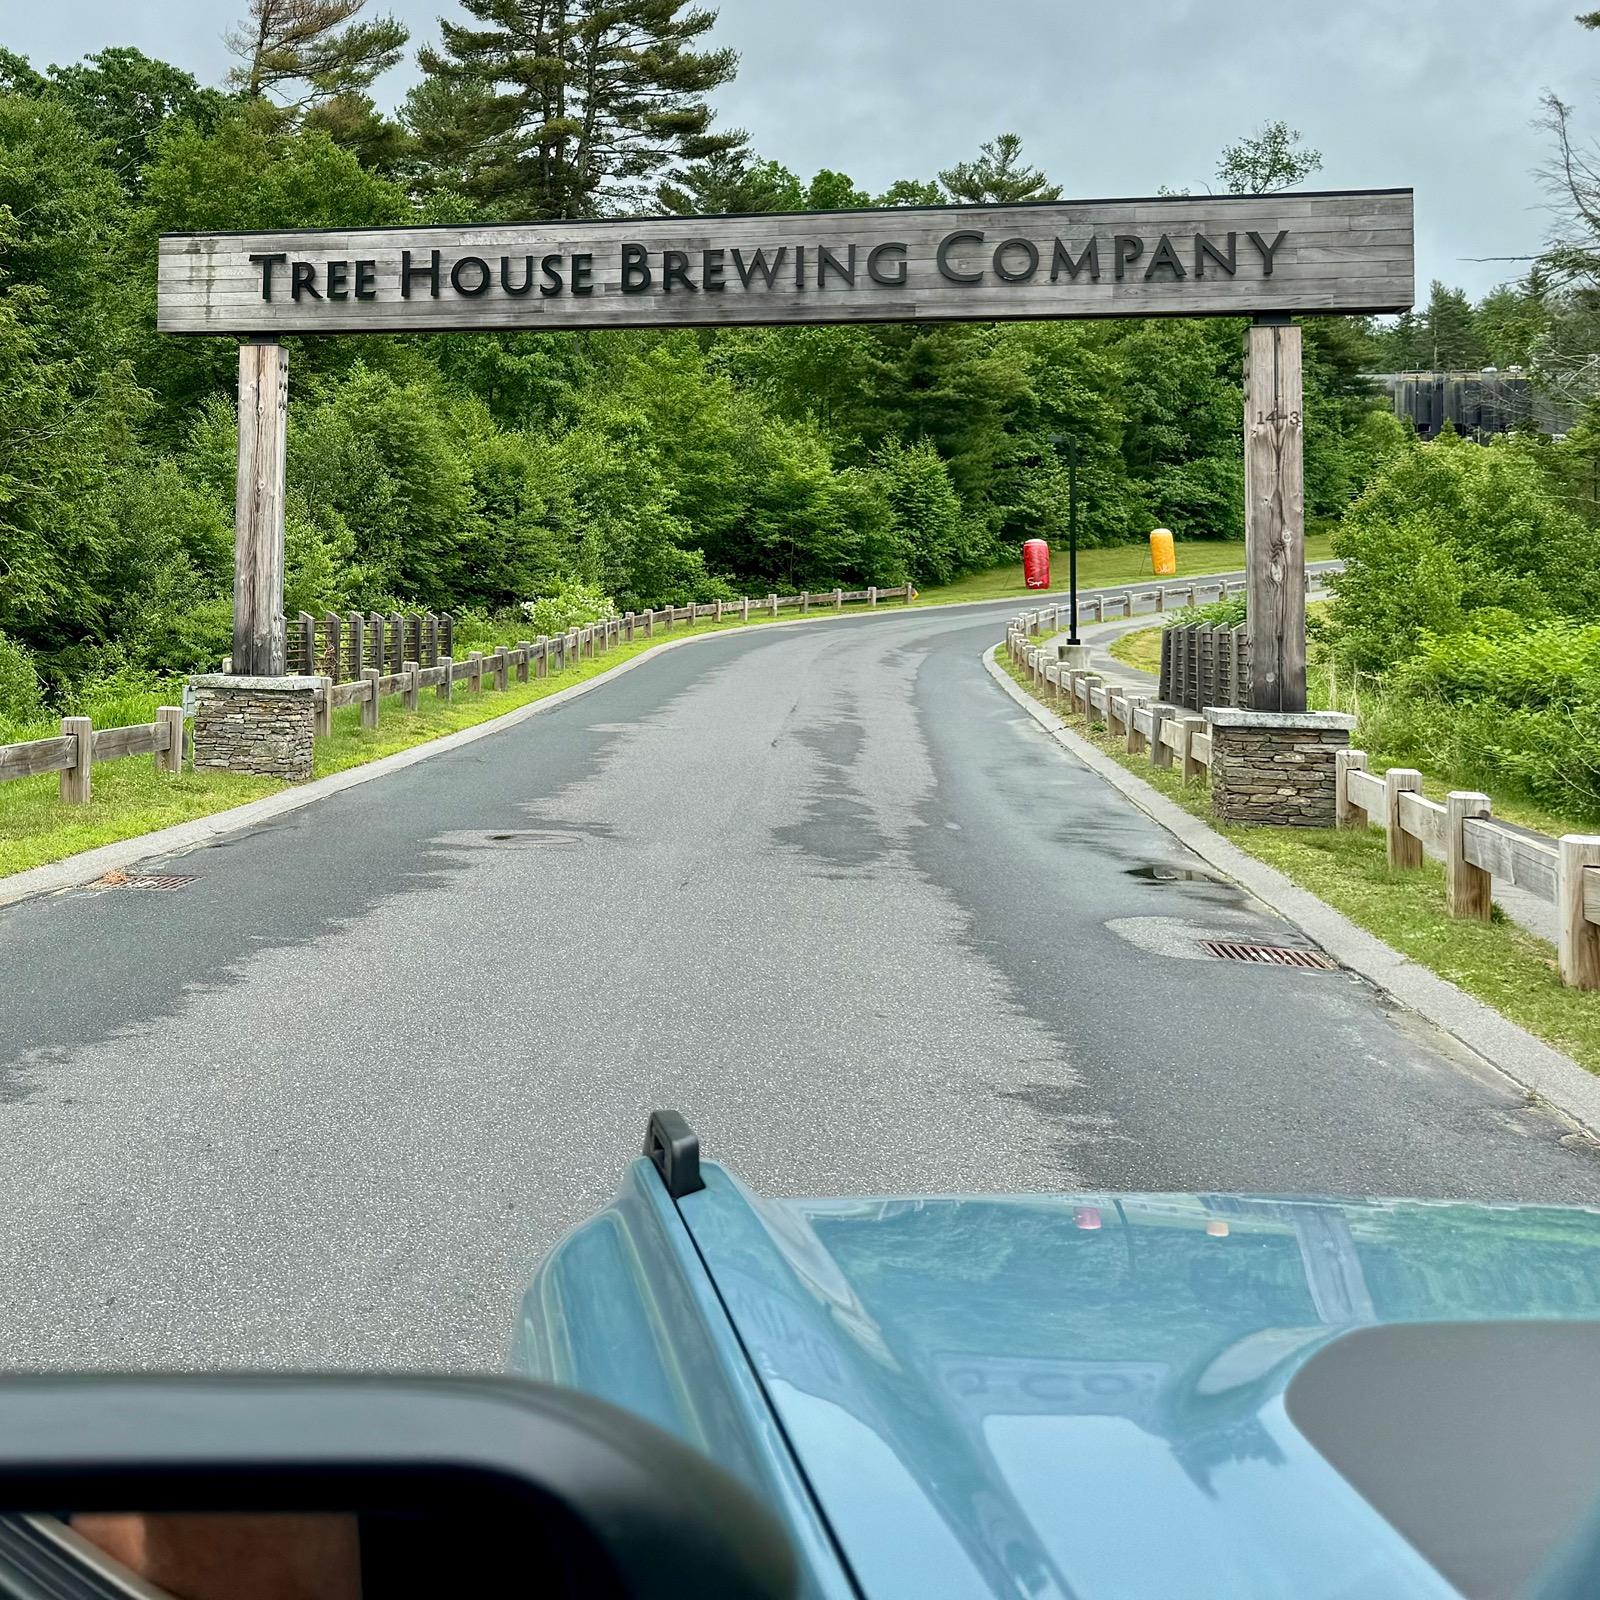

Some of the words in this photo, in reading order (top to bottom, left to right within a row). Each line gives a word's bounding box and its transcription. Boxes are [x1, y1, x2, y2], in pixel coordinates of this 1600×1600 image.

[249, 252, 376, 301] TREE
[402, 249, 595, 298] HOUSE
[621, 243, 907, 292] BREWING
[937, 229, 1289, 283] COMPANY
